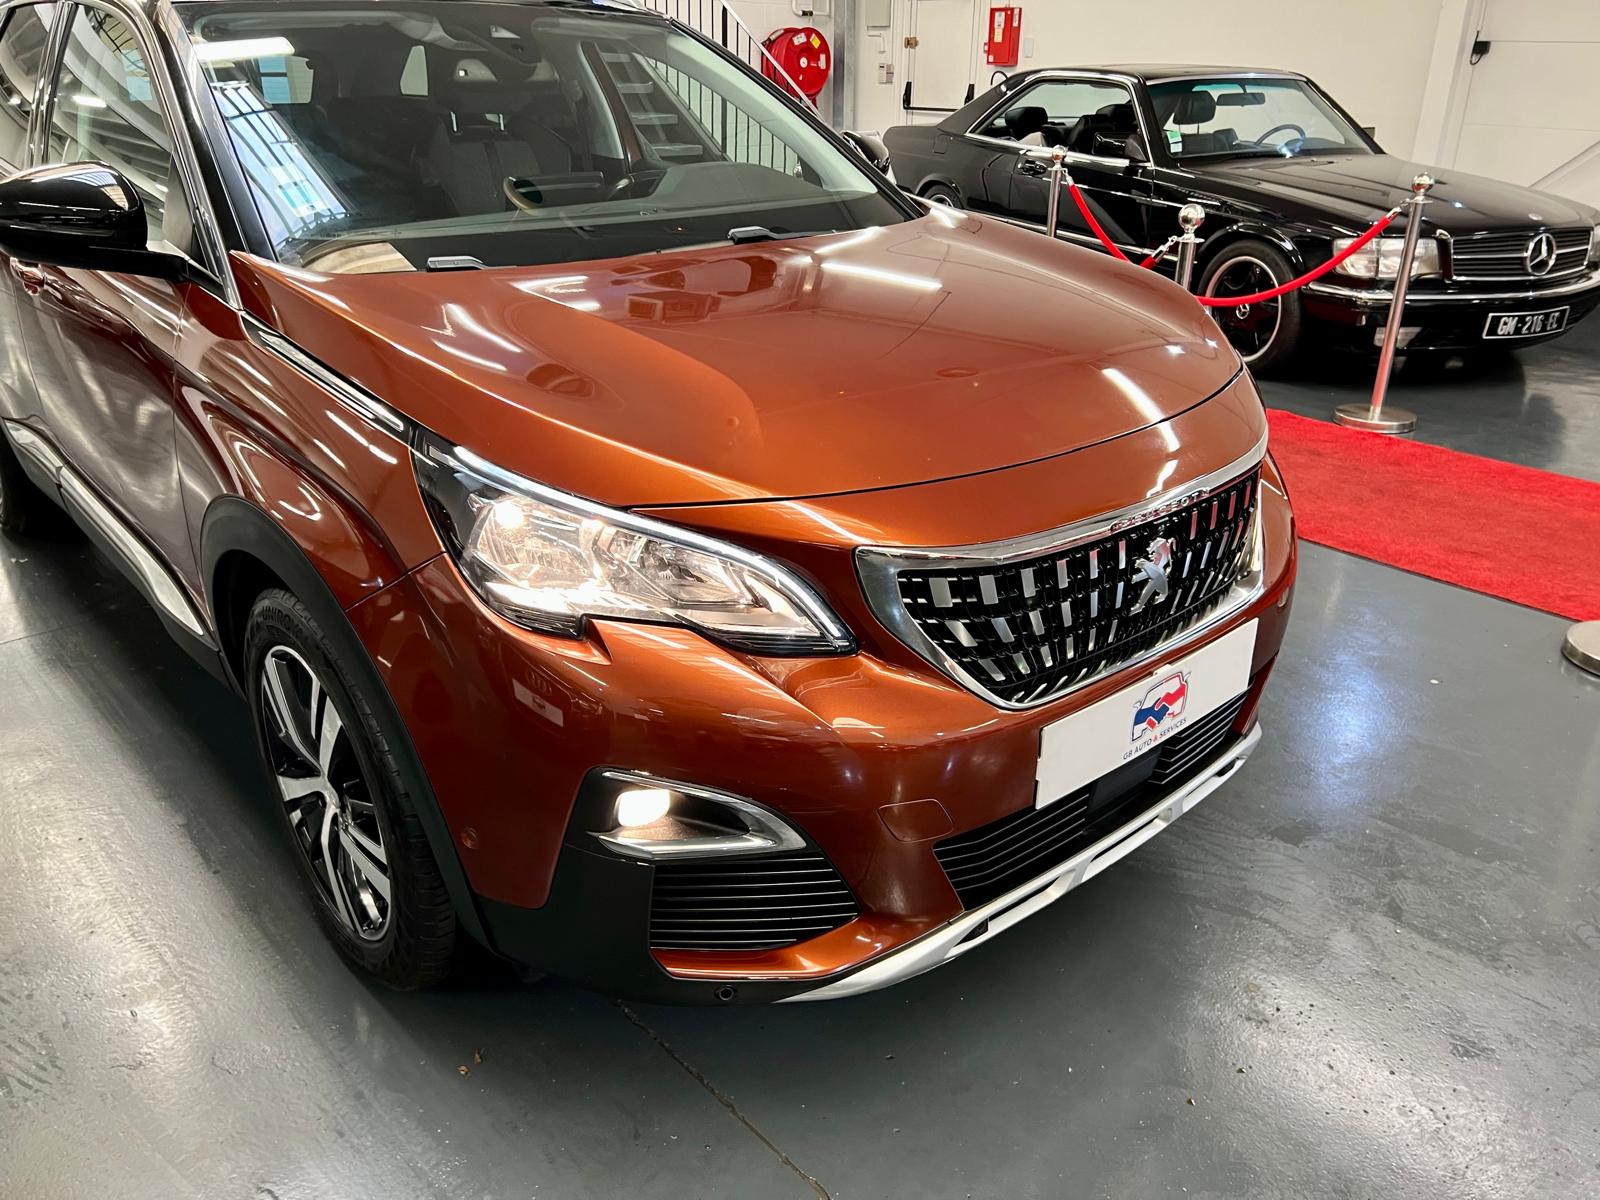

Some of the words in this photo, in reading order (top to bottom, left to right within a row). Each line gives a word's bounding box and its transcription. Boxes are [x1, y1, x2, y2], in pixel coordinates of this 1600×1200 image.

[1123, 749, 1133, 760] GB
[1134, 738, 1152, 755] AUTO
[1152, 734, 1158, 743] &
[1159, 717, 1187, 739] SERVICES
